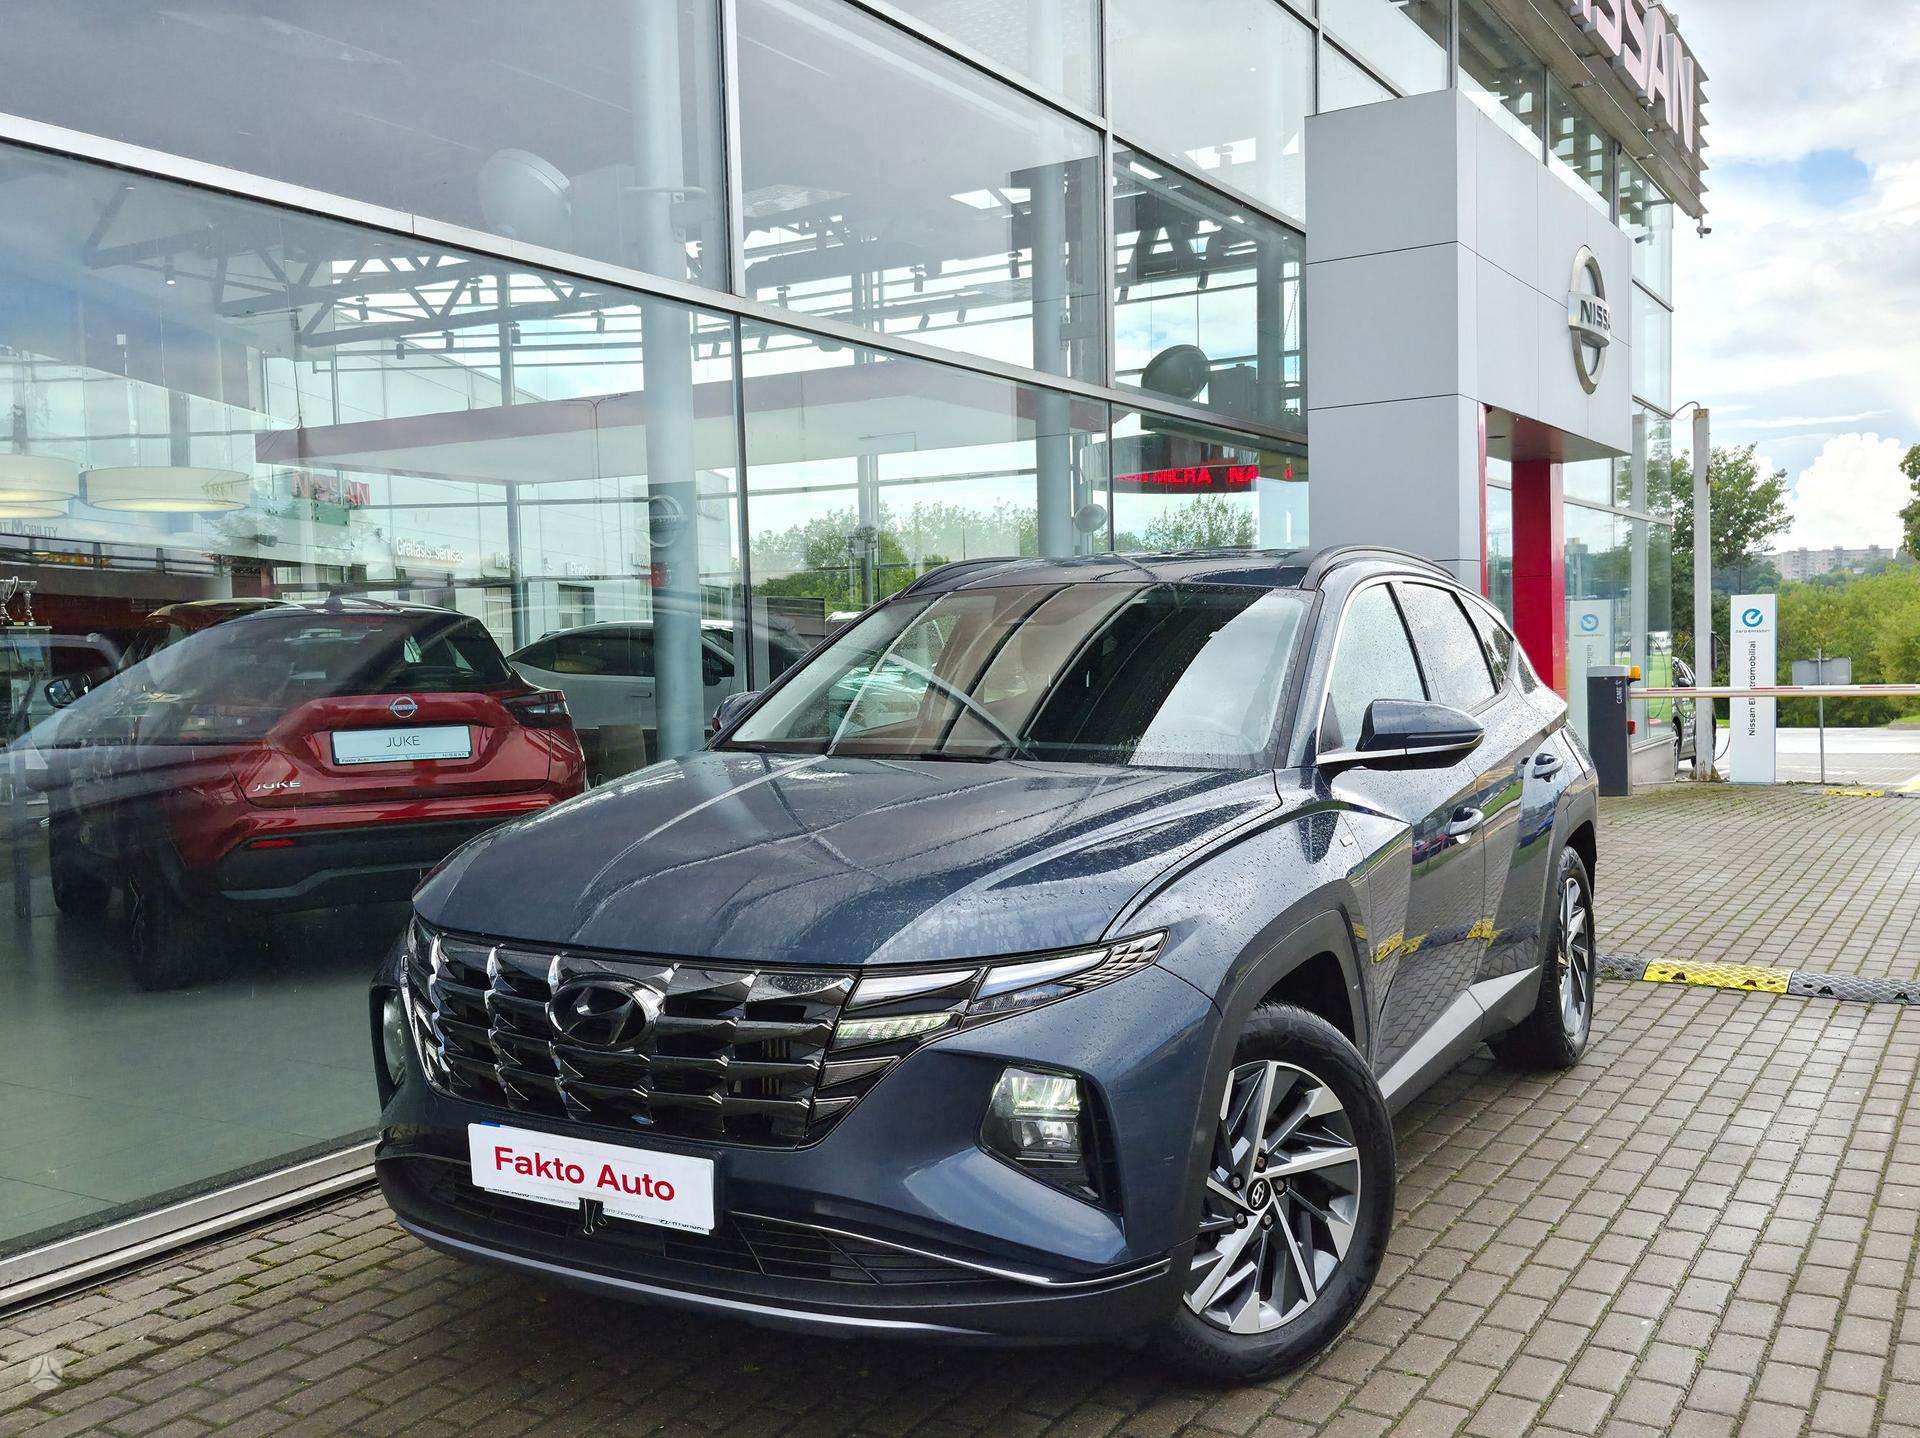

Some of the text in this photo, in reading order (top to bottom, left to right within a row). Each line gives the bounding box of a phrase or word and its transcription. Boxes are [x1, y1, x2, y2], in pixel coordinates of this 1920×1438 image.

[1580, 299, 1611, 332] NISS
[1748, 708, 1756, 736] Nissan
[386, 735, 420, 747] JUKE
[252, 781, 301, 791] JUKE
[494, 1146, 675, 1201] Fakto Auto
